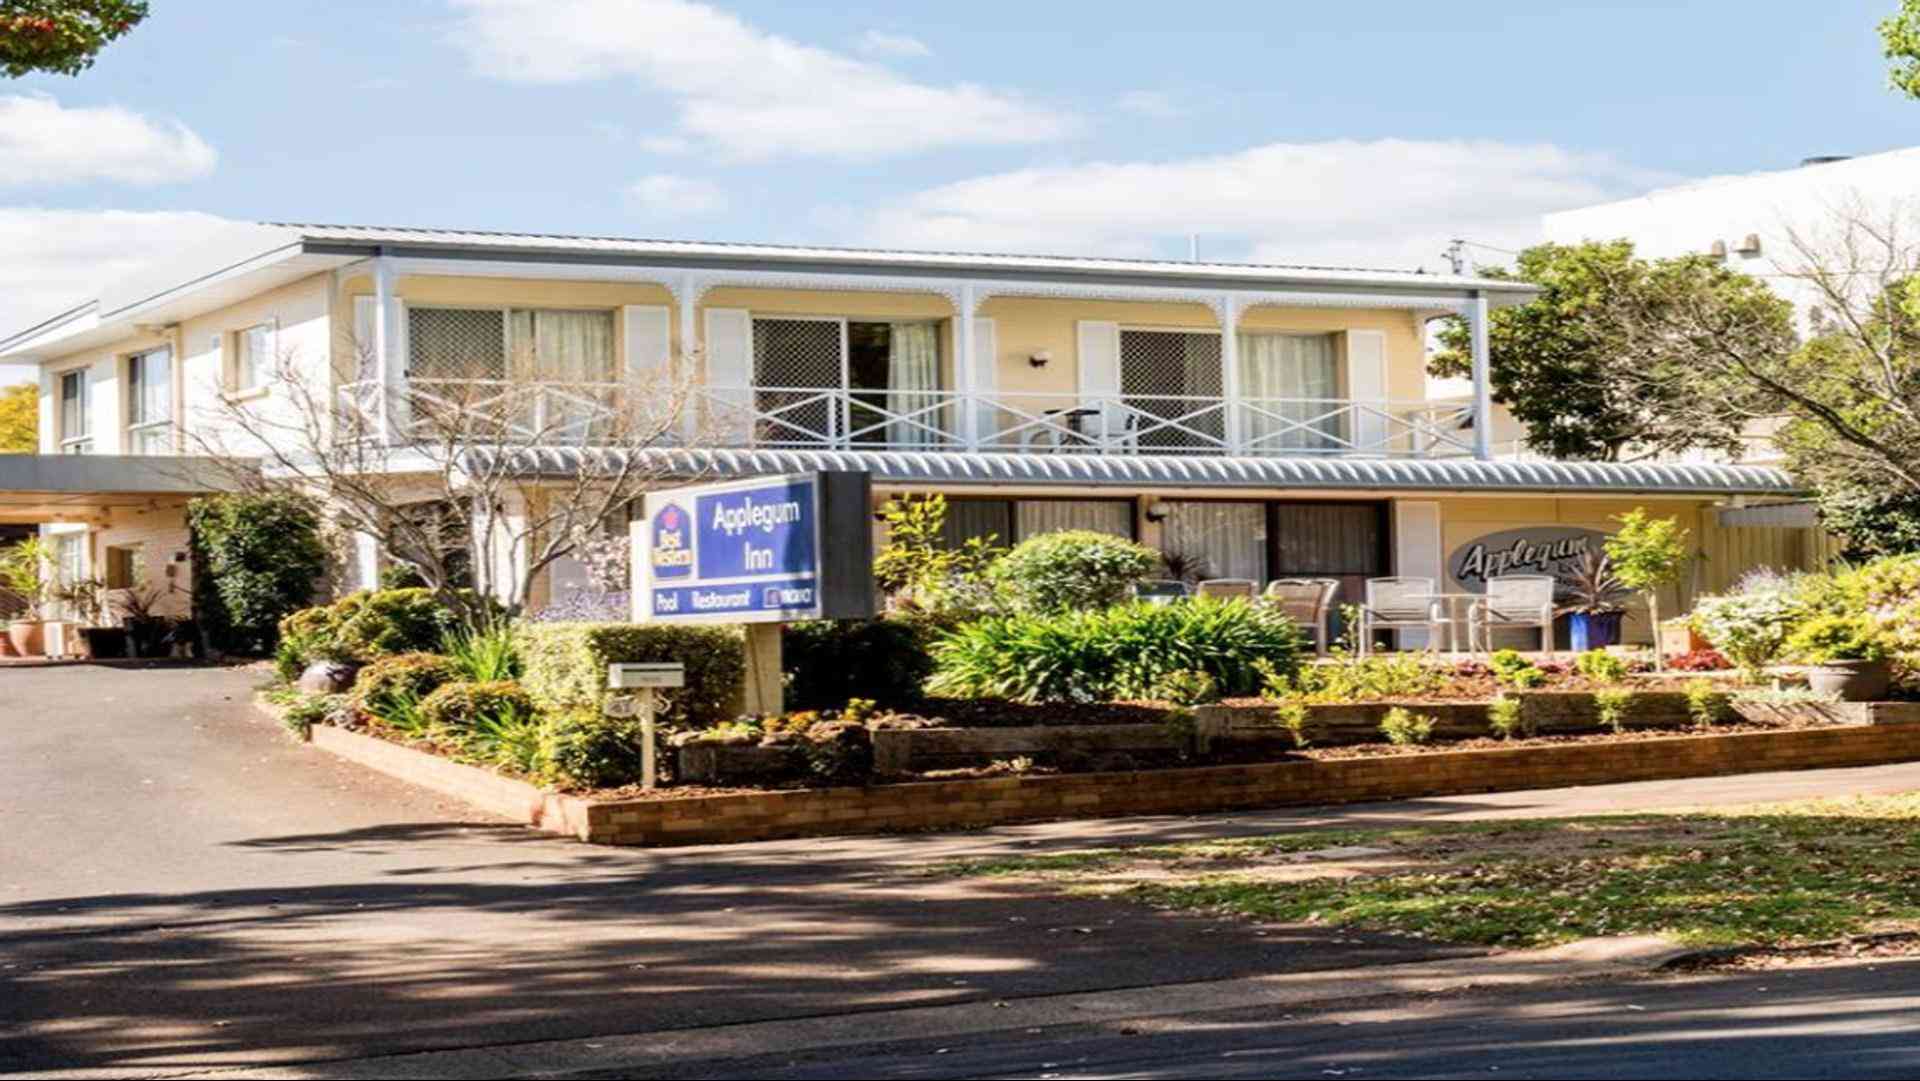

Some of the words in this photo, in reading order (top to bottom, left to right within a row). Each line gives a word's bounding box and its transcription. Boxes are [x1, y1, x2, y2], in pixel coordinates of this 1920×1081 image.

[713, 497, 800, 535] Applegum
[744, 542, 773, 570] Inn
[656, 593, 679, 612] Pool
[691, 590, 752, 609] Restaurant
